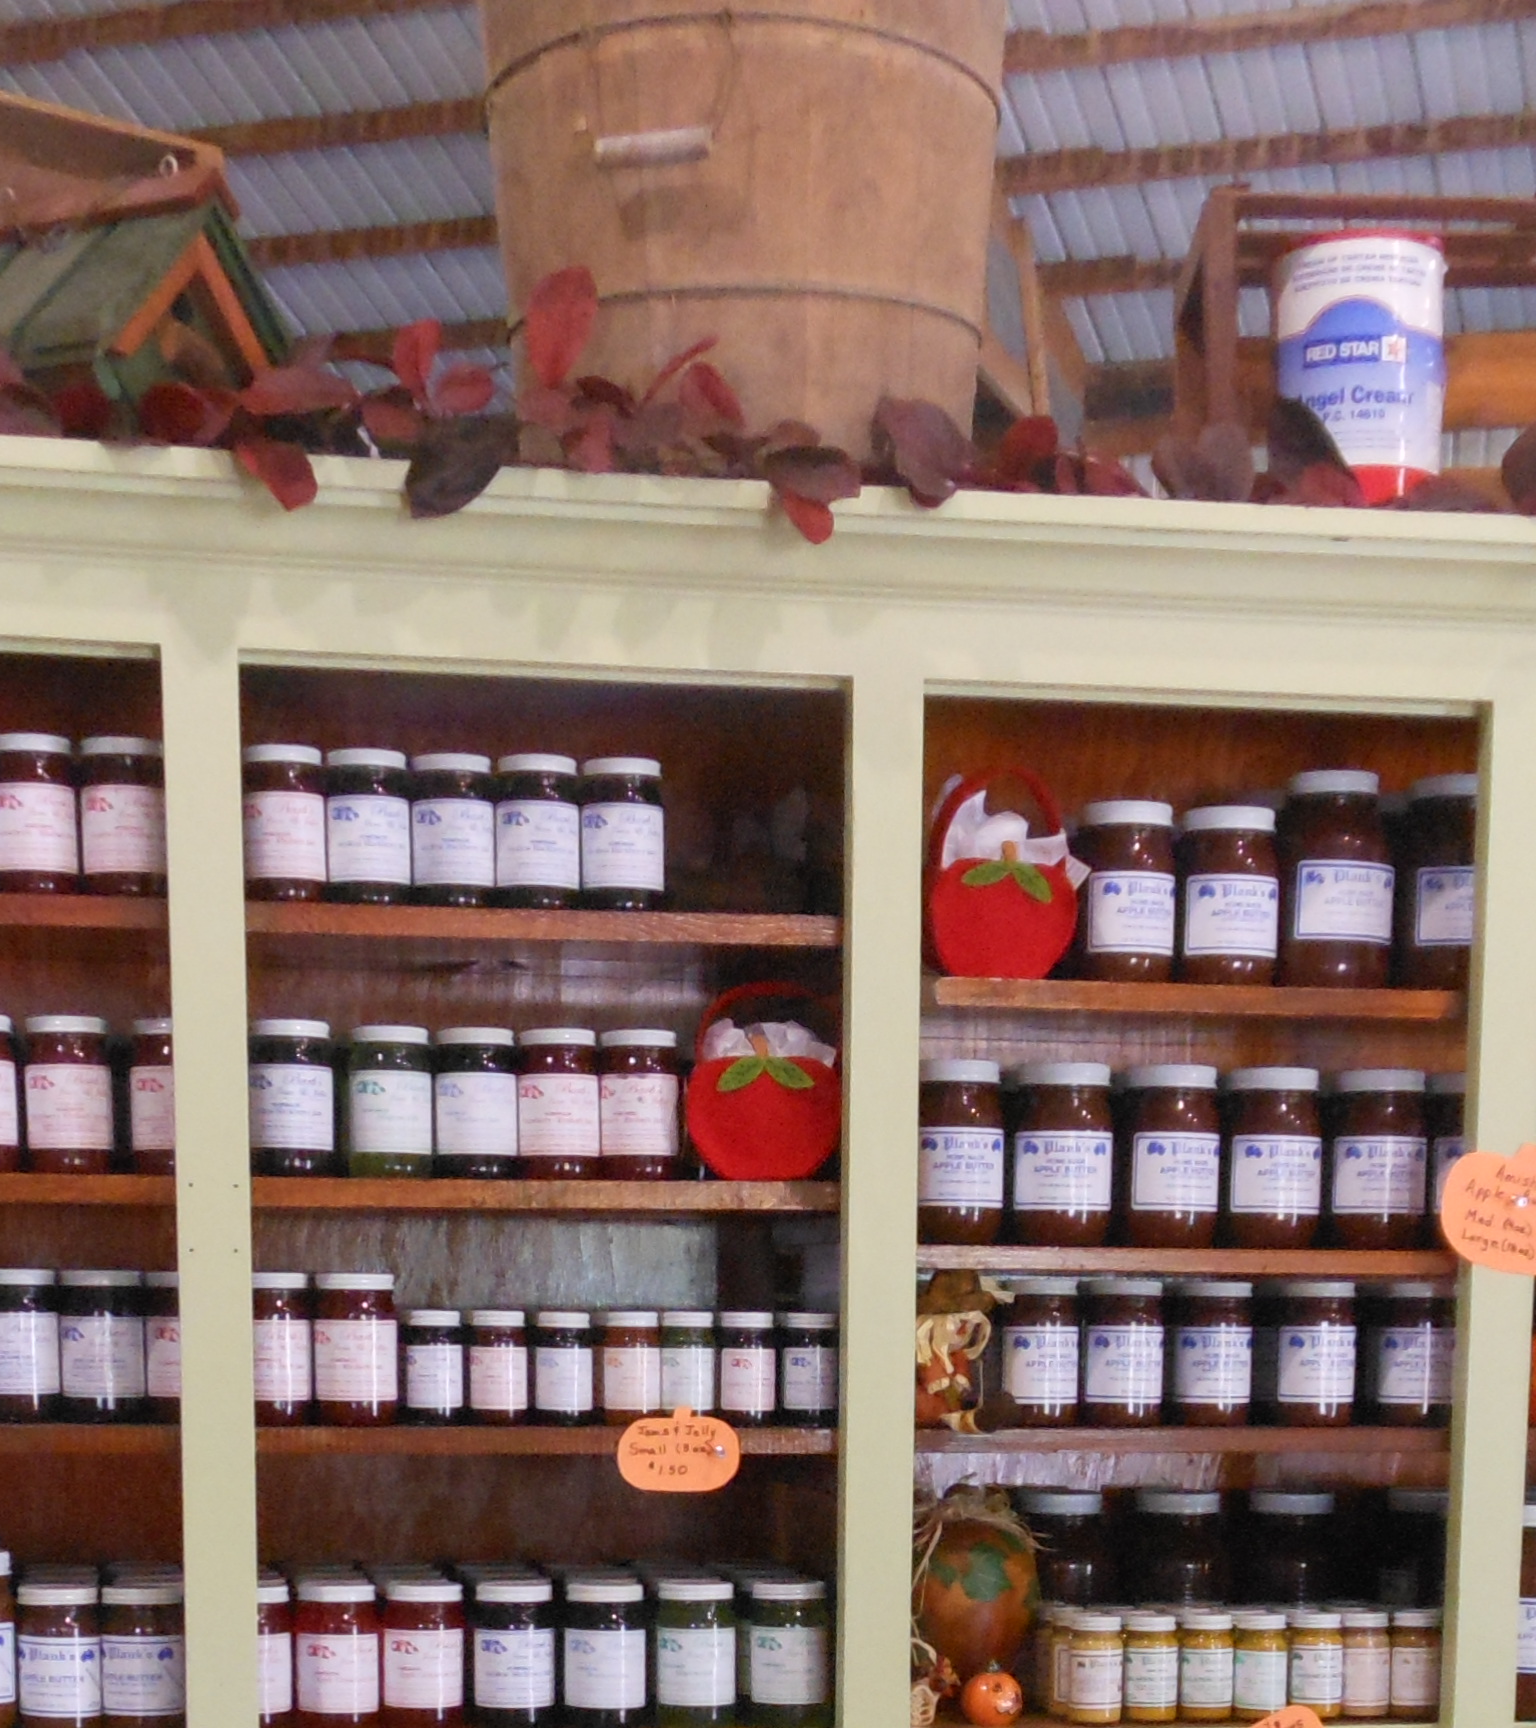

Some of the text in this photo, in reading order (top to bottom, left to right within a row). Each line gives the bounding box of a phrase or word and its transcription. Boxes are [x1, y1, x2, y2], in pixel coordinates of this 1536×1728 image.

[1306, 341, 1379, 362] RED STAR
[1465, 1178, 1504, 1202] Apple
[1462, 1228, 1499, 1251] Large
[638, 1426, 669, 1436] Jams
[629, 1442, 666, 1455] Small
